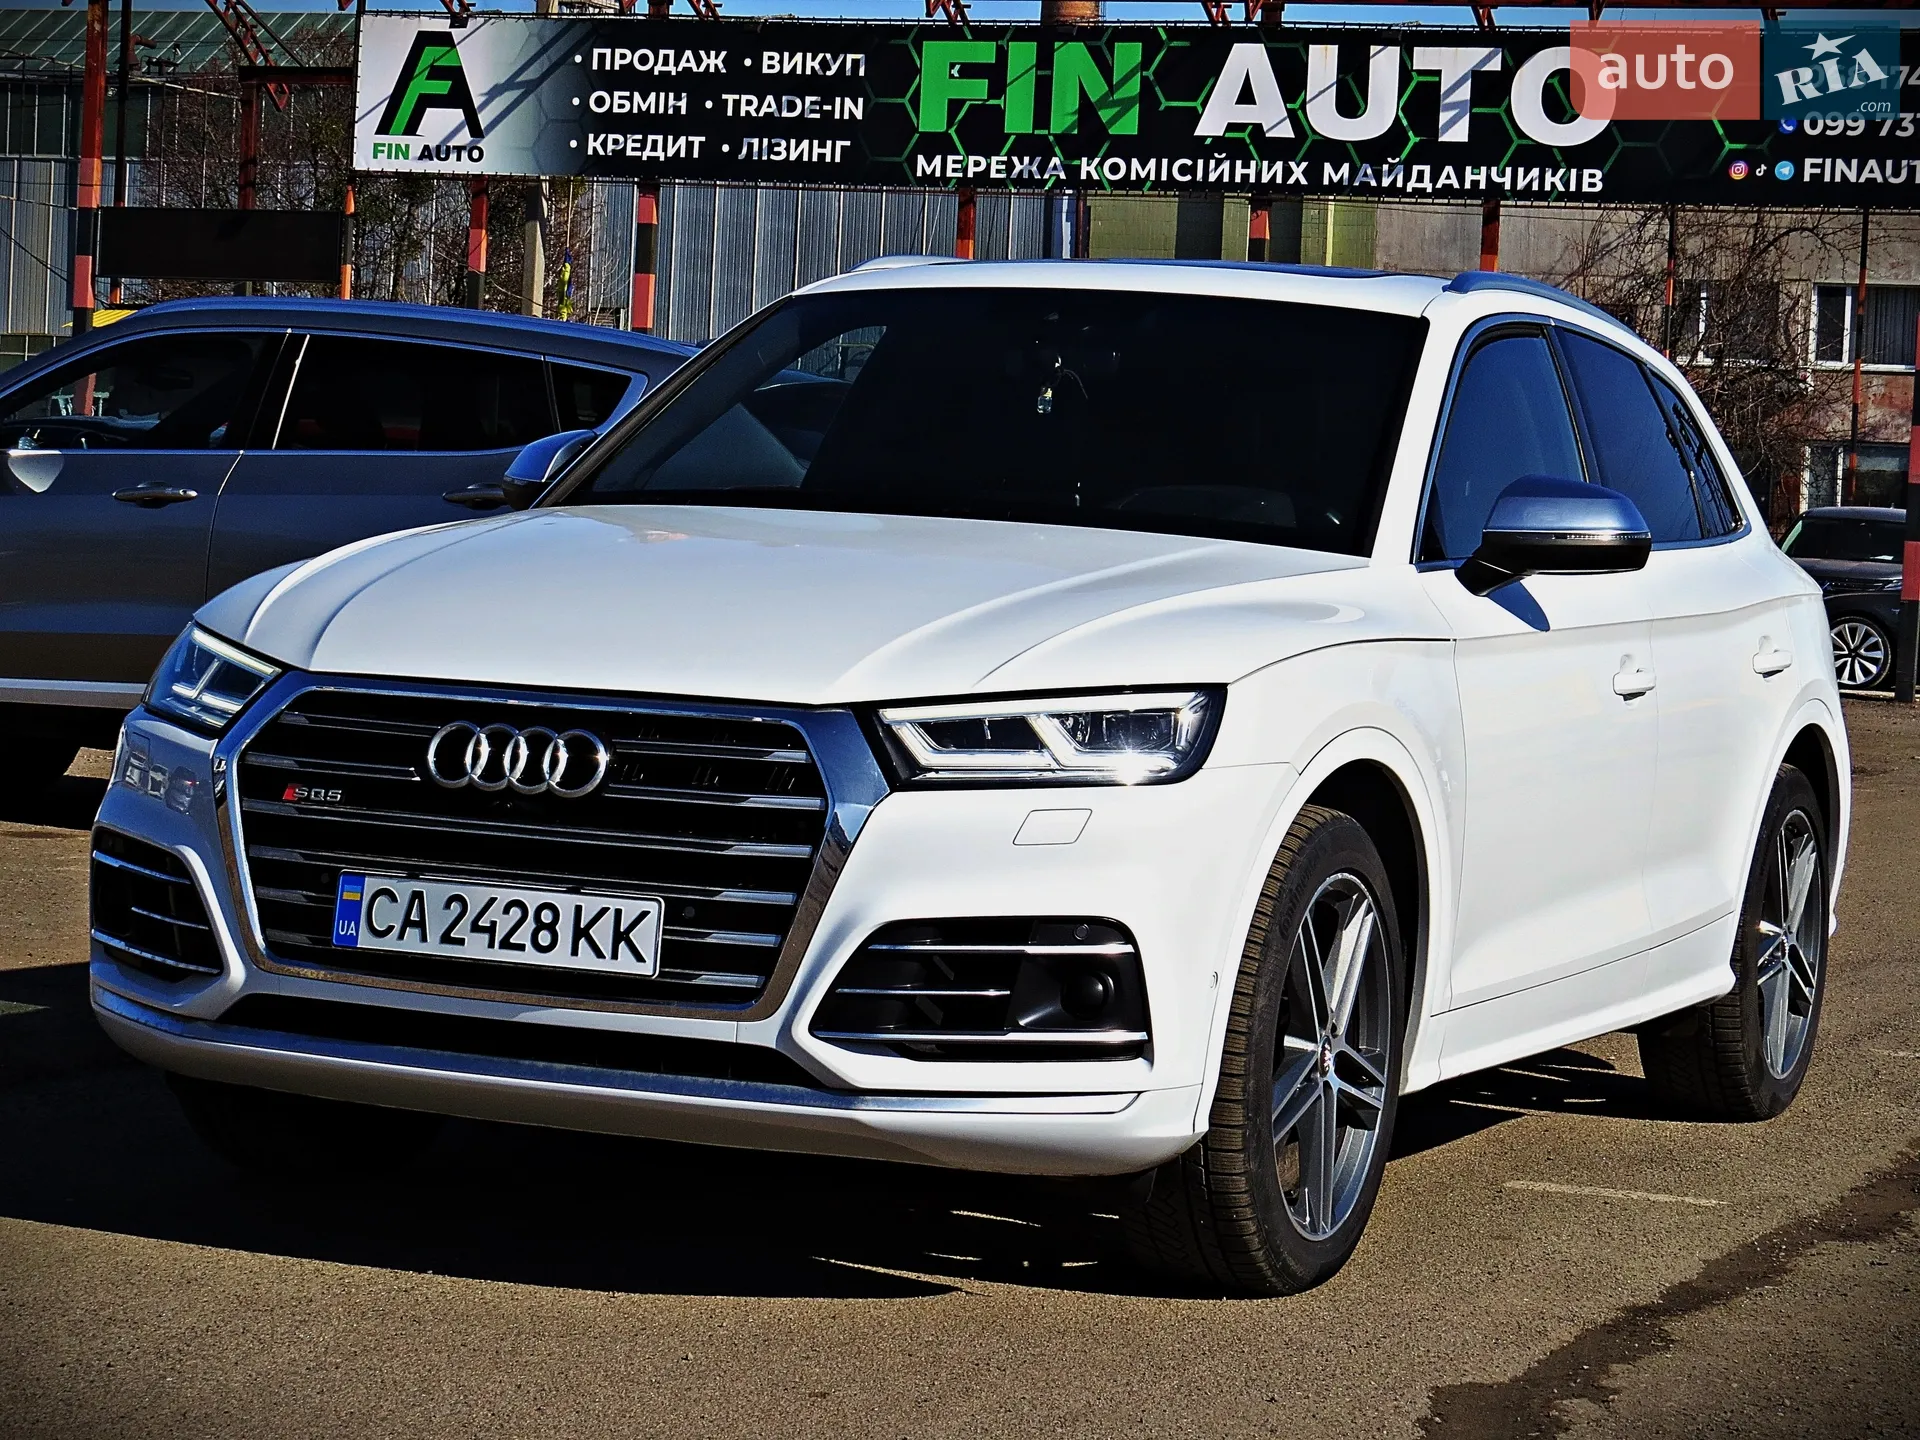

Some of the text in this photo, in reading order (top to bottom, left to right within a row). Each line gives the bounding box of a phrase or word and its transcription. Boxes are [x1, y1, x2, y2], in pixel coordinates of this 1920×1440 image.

[592, 47, 866, 77] ПРОДАЖ ВИКУП
[588, 90, 688, 116] ОБМІН
[721, 93, 864, 120] TRADE-IN
[918, 40, 1617, 147] FIN AUTO
[1803, 110, 1920, 138] 099 73
[372, 142, 485, 163] FIN AUTO
[587, 133, 852, 163] КРЕДИТ ЛІЗИНГ
[915, 152, 1604, 193] МЕРЕЖА КОМІСІЙНИХ МАЙДАНЧИКІВ
[293, 787, 343, 802] SQ5
[338, 919, 357, 937] UA
[365, 886, 652, 964] CA 2428 KK
